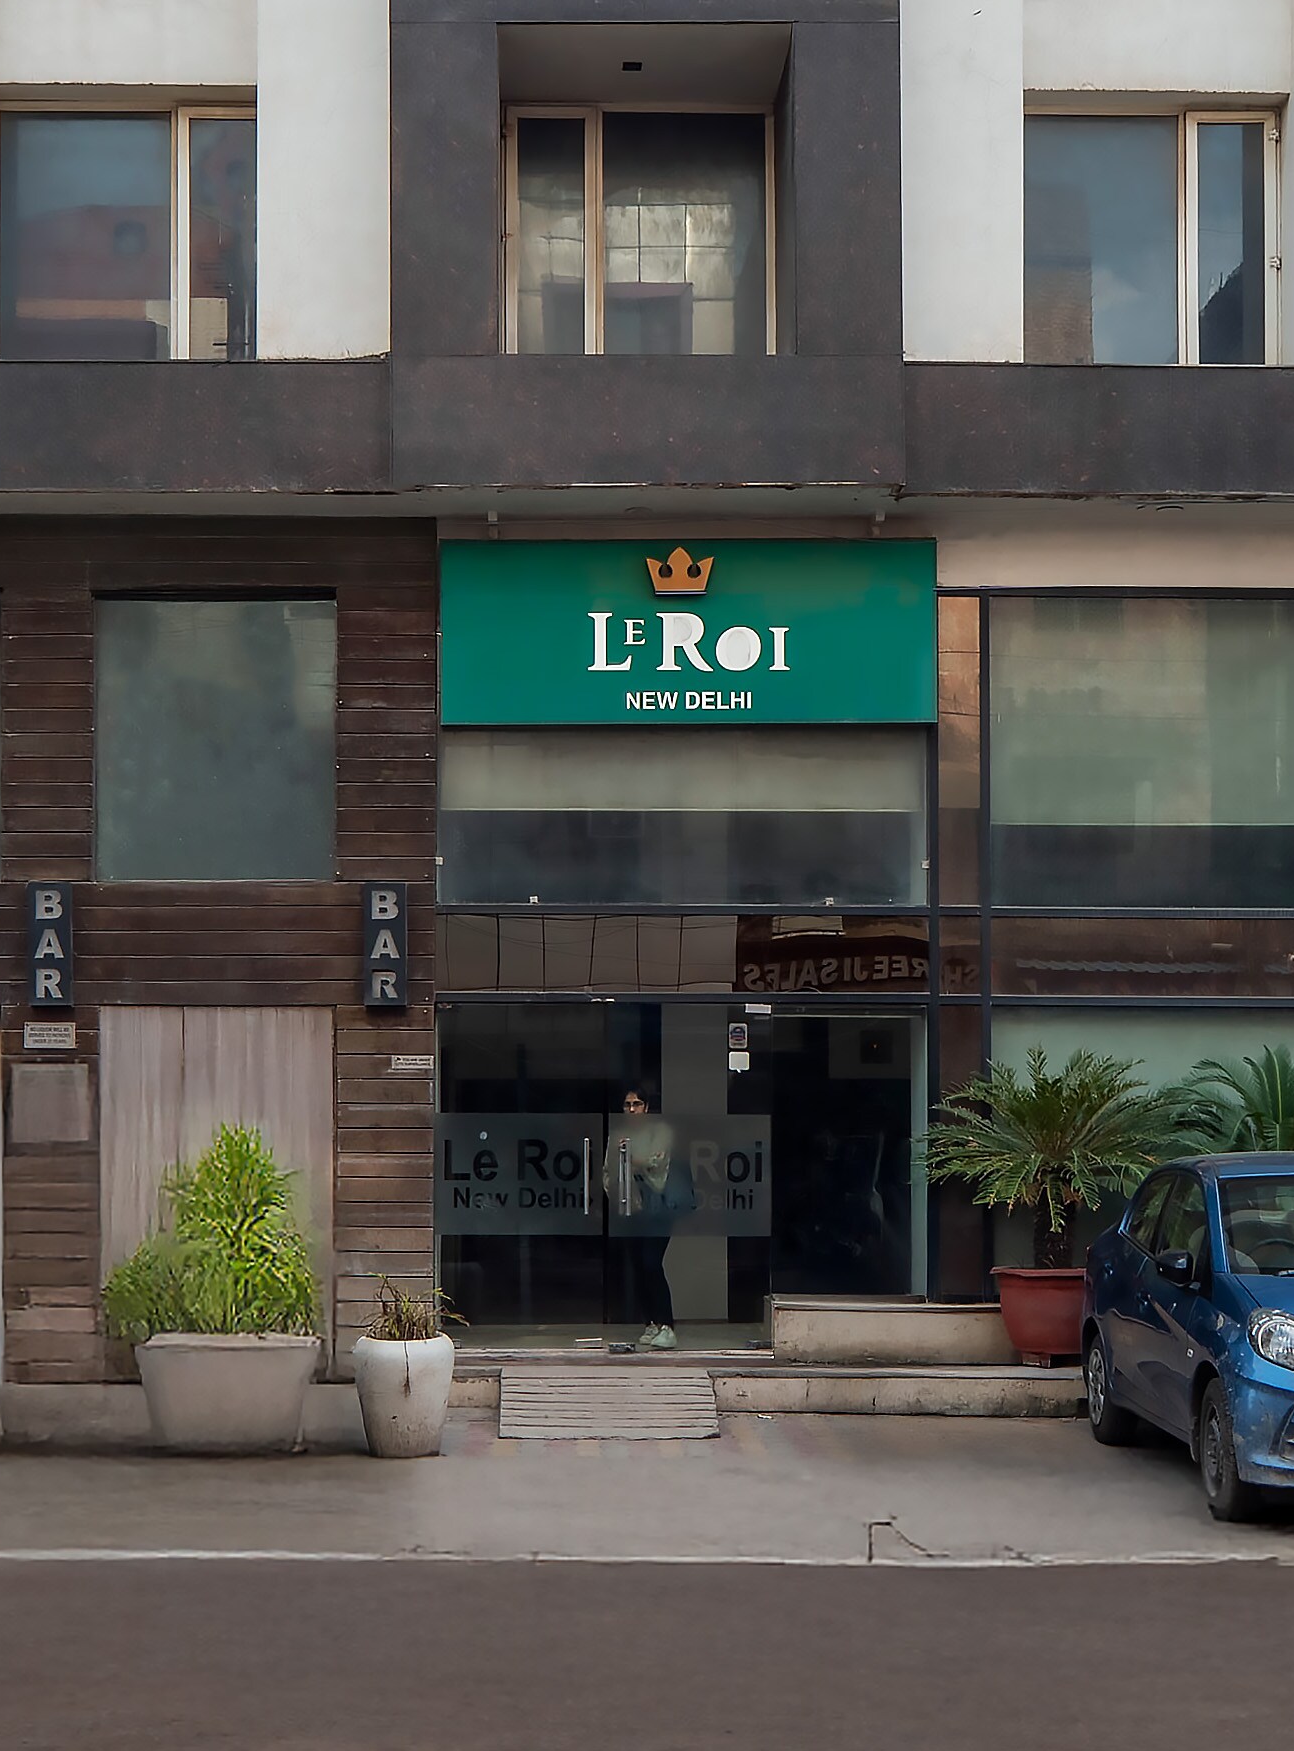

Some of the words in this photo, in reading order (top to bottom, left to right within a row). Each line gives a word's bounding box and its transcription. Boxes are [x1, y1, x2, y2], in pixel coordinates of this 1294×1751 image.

[626, 691, 679, 710] NEW
[685, 691, 752, 710] DELHI
[35, 890, 65, 999] BAR
[371, 890, 399, 999] BAR
[444, 1139, 499, 1182] Le
[517, 1139, 593, 1182] Roi
[454, 1187, 509, 1210] New
[518, 1187, 584, 1210] Delhi
